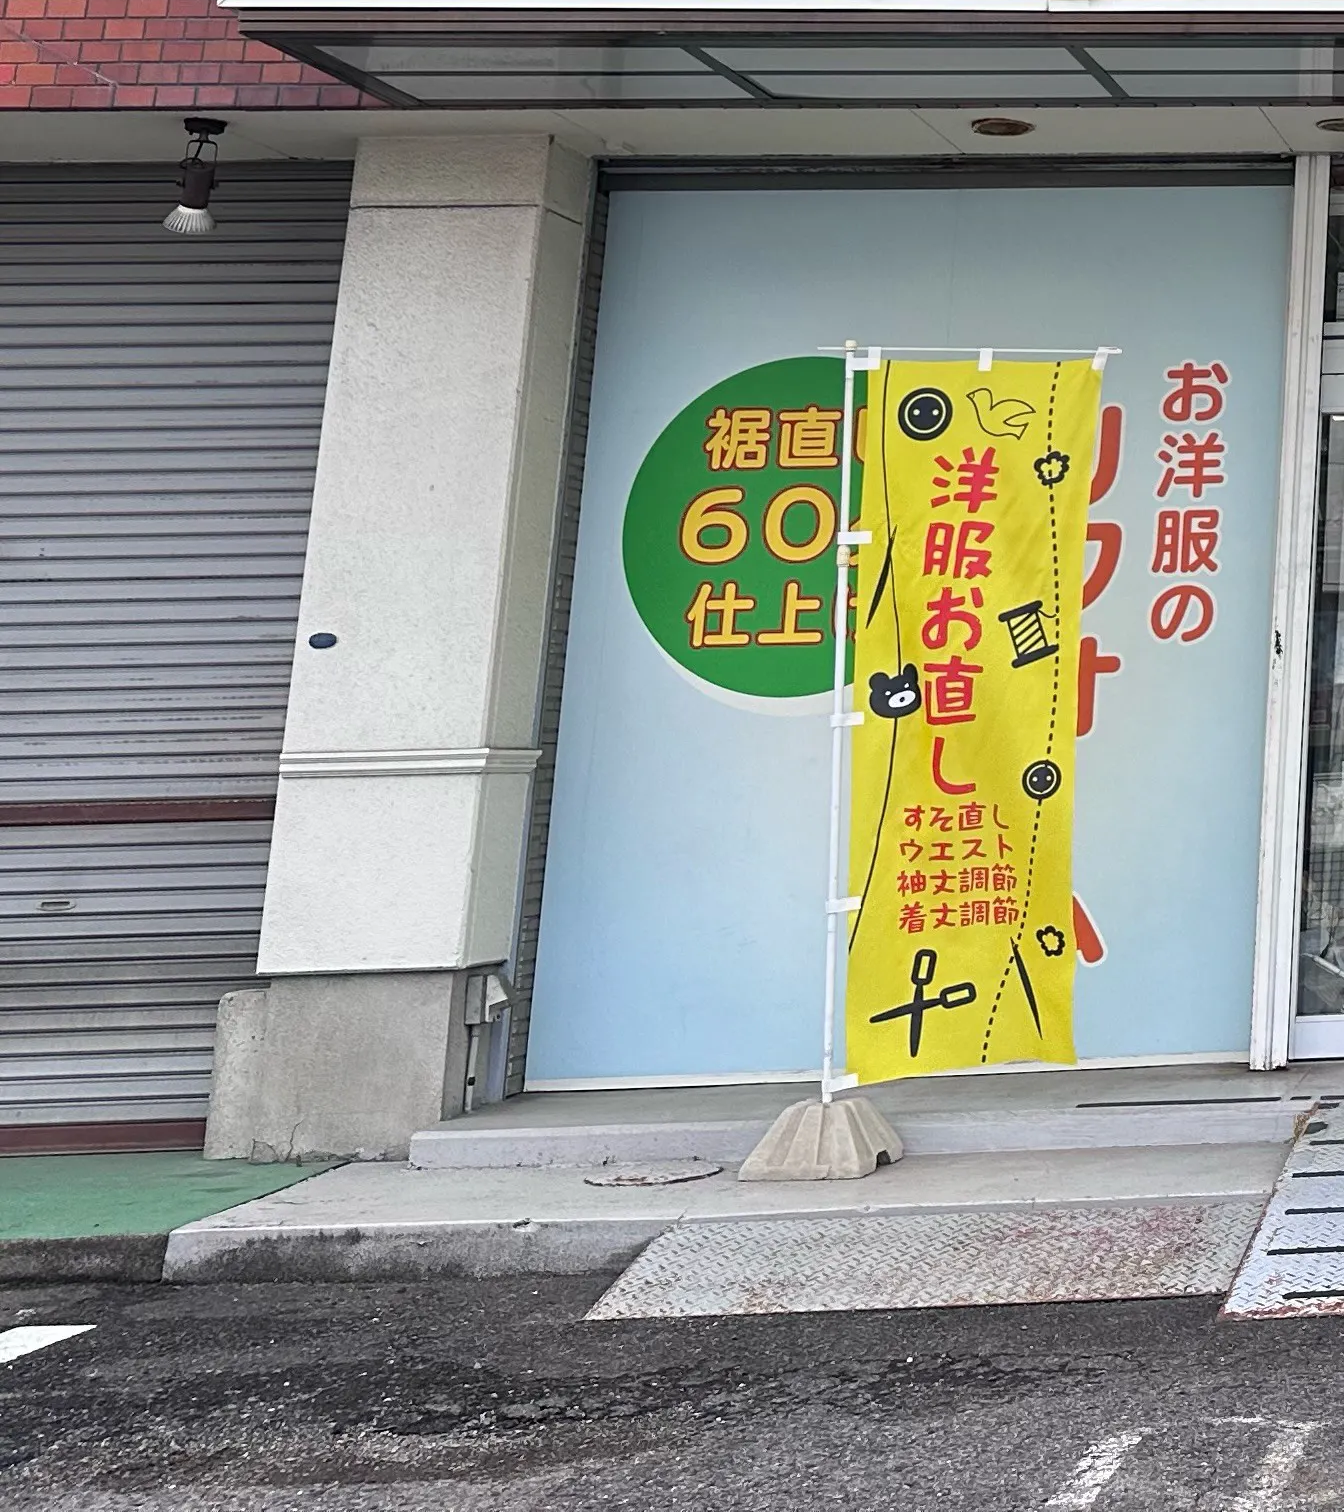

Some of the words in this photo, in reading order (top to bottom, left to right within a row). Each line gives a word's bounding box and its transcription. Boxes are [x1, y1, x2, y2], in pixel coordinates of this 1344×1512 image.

[1150, 363, 1229, 643] お洋服の
[680, 485, 860, 564] 60
[922, 447, 998, 795] 洋服お直し
[903, 801, 1010, 832] すそ直し
[899, 833, 1014, 862] ウエスト
[897, 863, 1018, 897] 袖丈調節
[898, 895, 1020, 935] 着丈調節
